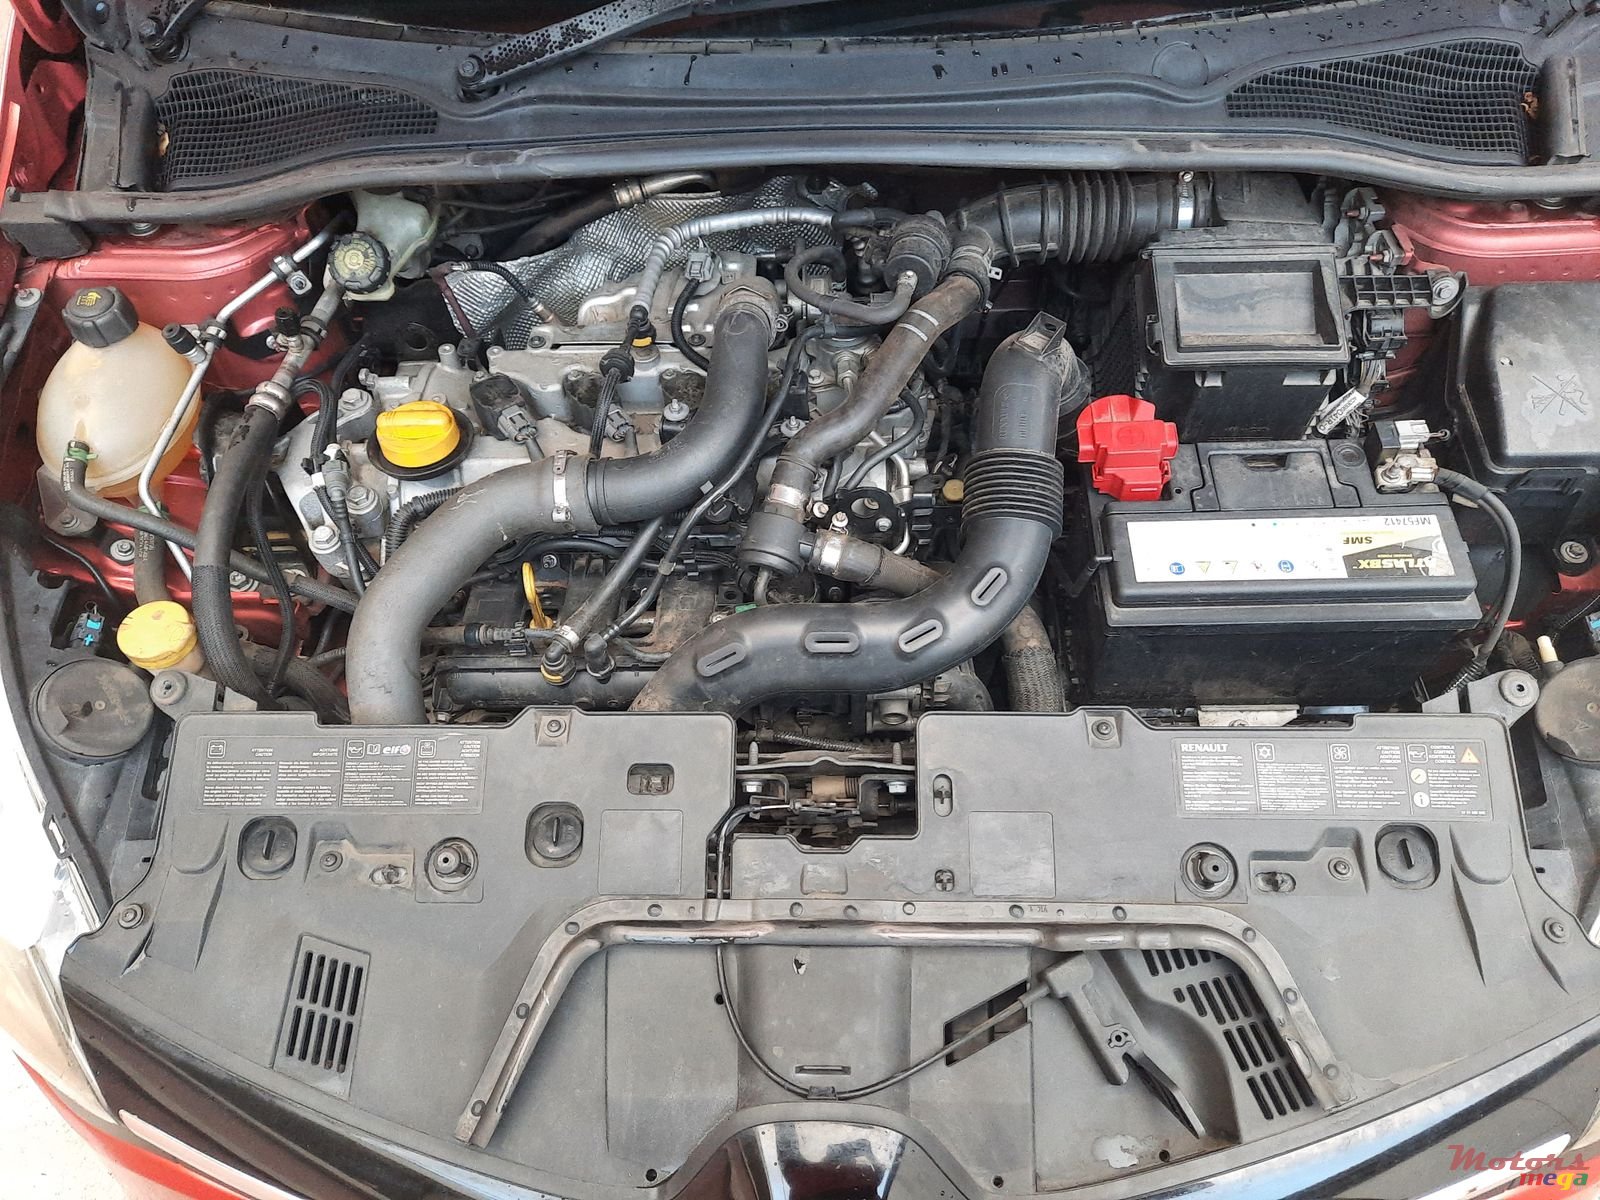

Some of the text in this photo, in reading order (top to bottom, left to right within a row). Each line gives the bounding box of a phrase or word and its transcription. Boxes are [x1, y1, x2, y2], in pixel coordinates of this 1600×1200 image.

[1384, 517, 1432, 526] MF57412
[1343, 536, 1373, 545] SMF
[382, 745, 401, 755] elf
[1180, 743, 1229, 753] RENAULT
